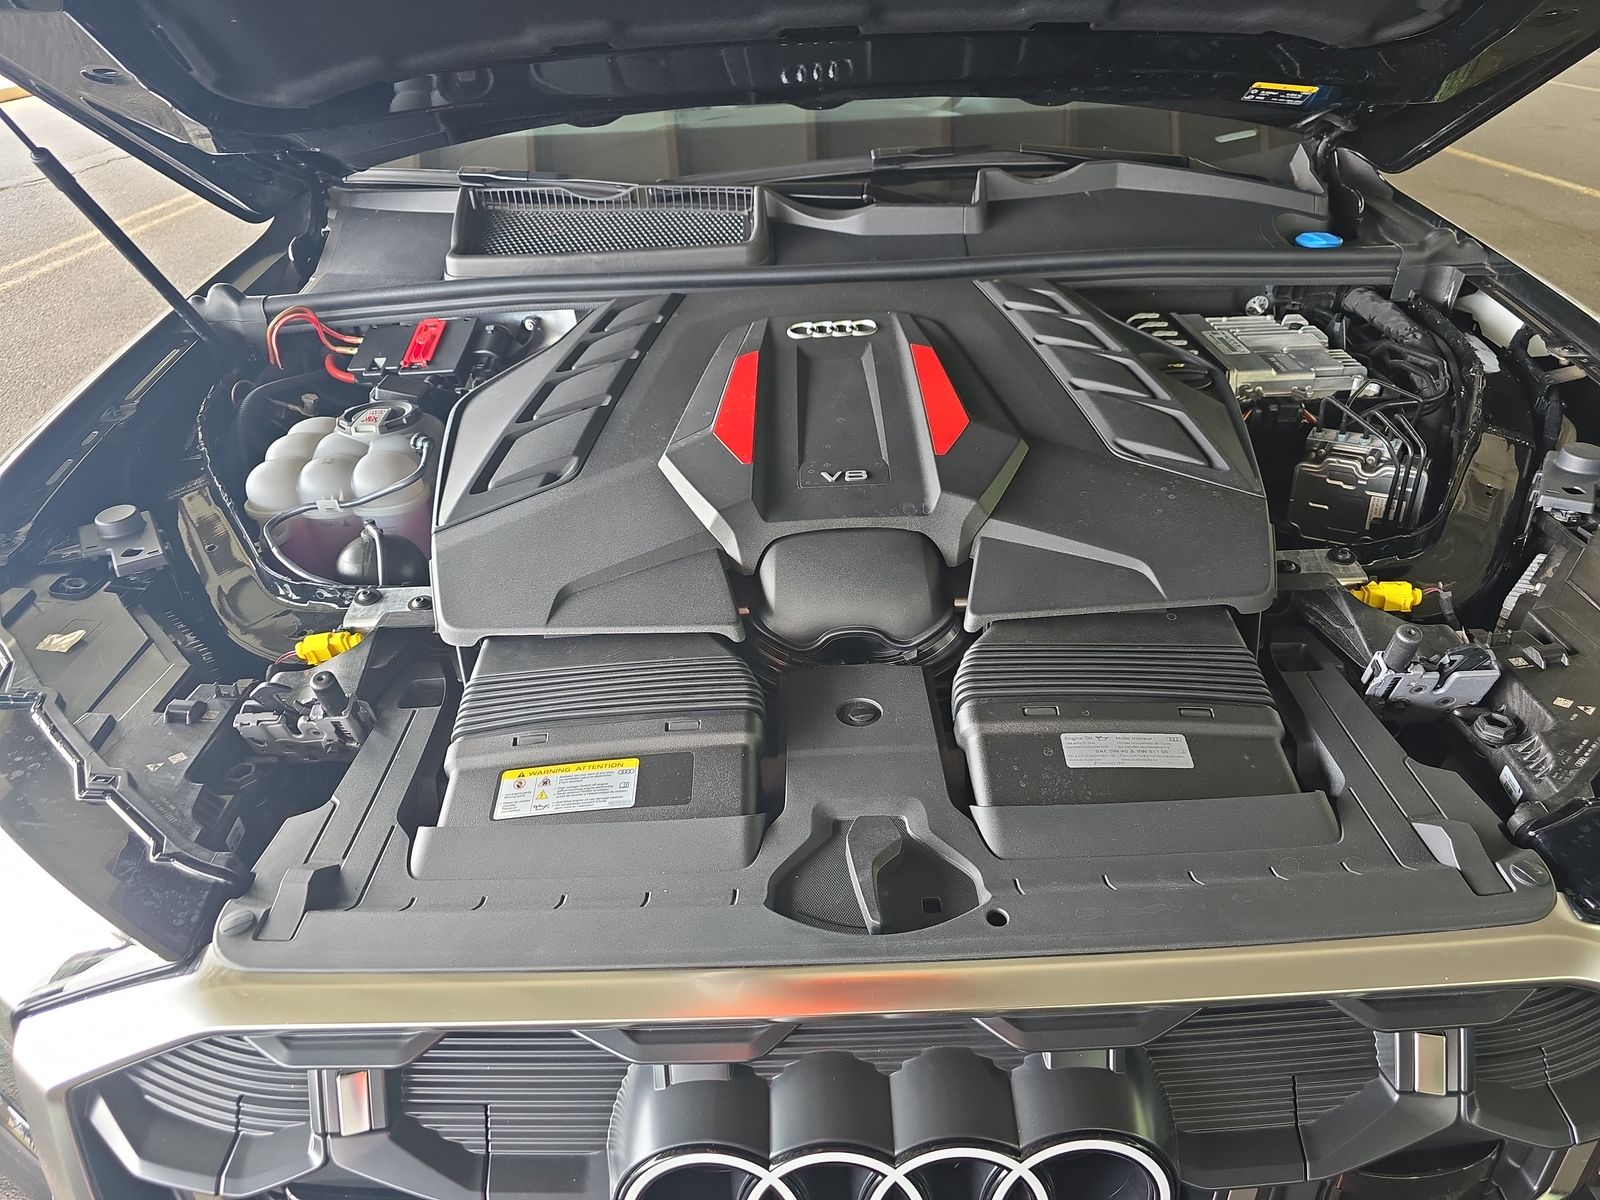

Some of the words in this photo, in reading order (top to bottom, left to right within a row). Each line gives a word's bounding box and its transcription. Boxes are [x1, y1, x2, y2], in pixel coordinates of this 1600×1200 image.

[820, 470, 868, 482] V8
[529, 767, 571, 777] WARNING
[575, 762, 624, 773] ATTENTION
